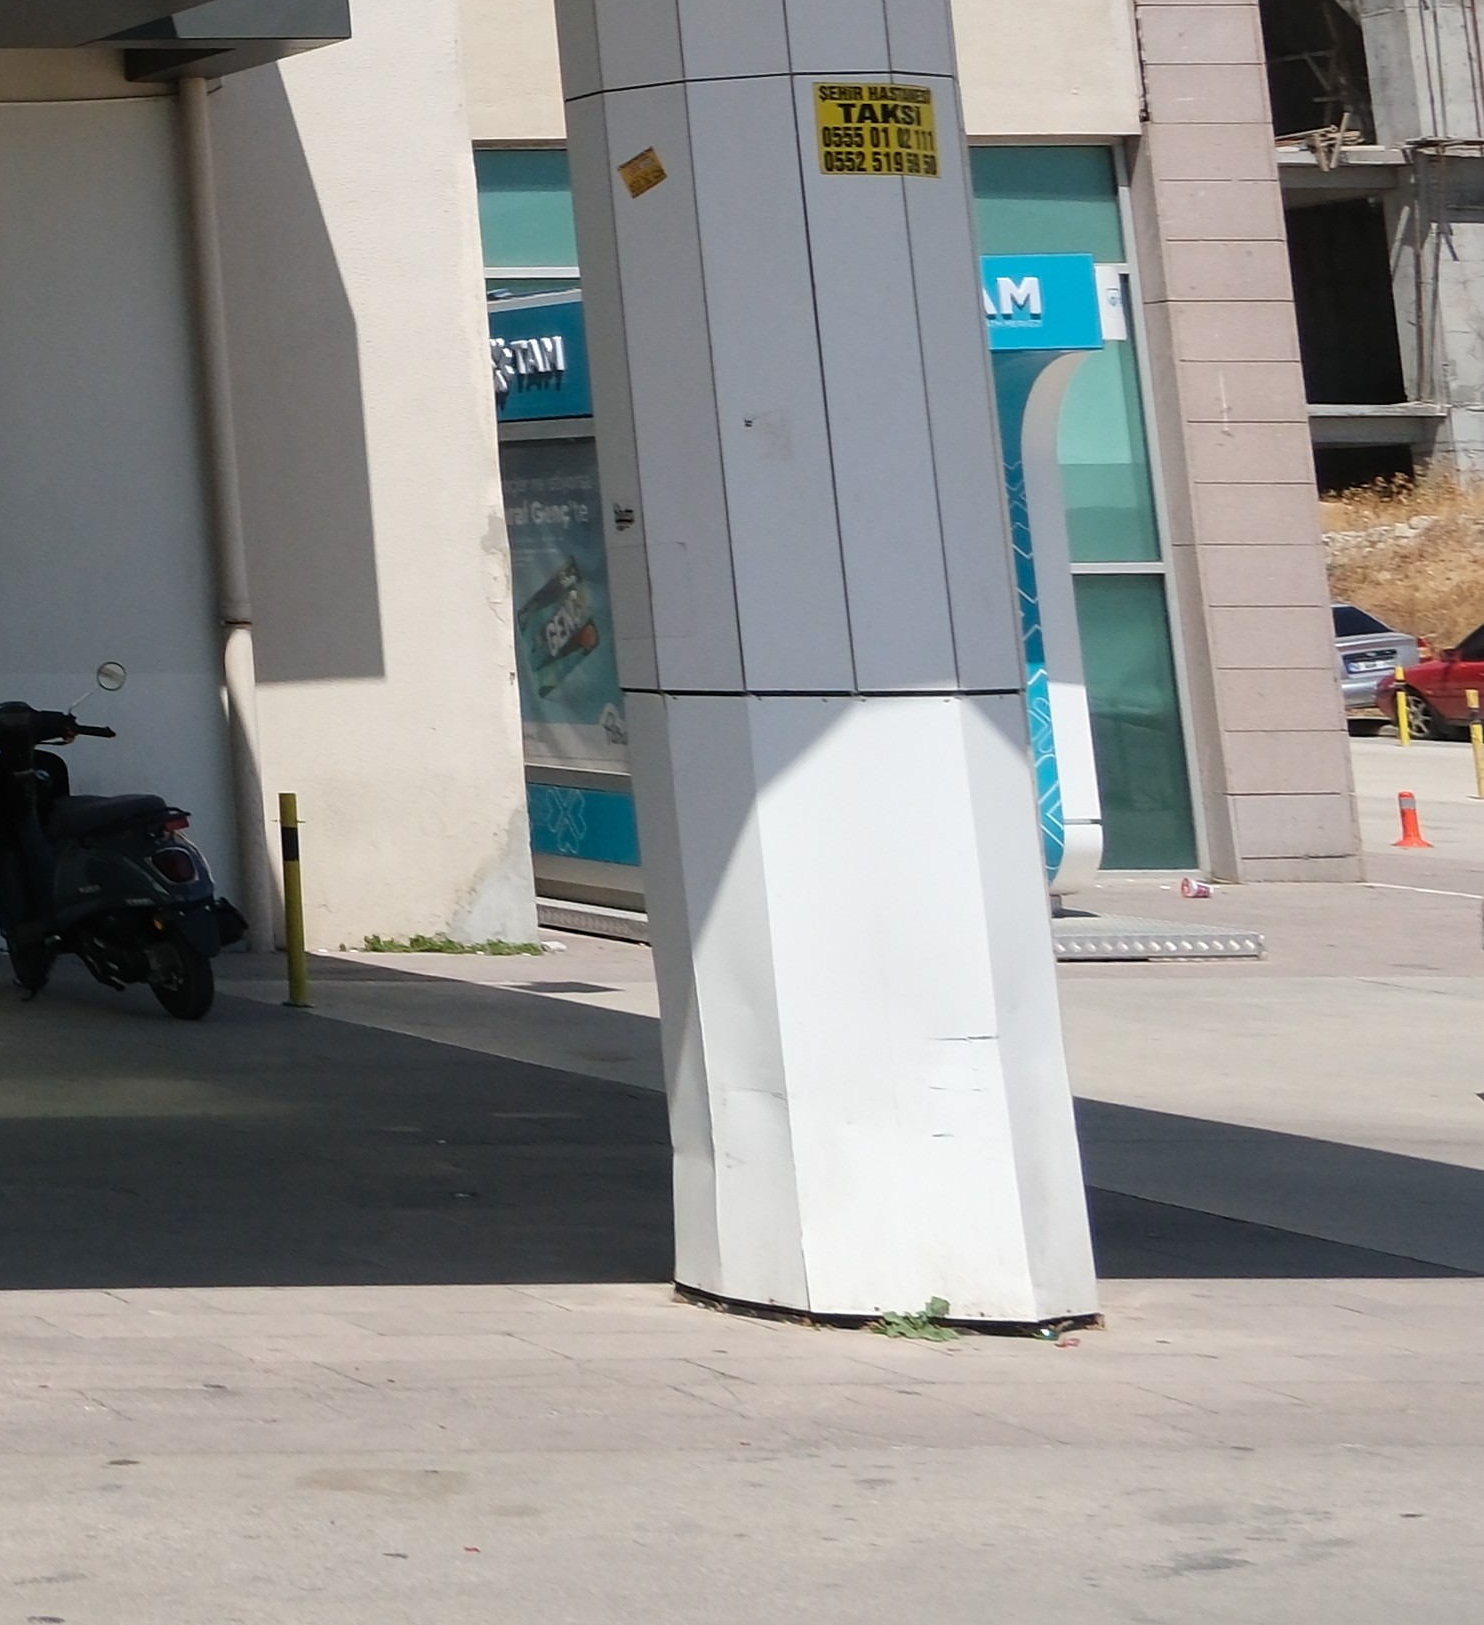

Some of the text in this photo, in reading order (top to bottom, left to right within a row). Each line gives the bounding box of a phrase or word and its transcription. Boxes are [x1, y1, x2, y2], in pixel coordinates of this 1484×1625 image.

[837, 103, 921, 126] TAKSİ
[822, 126, 864, 148] 0555
[869, 127, 891, 148] 01
[824, 151, 867, 172] 0552
[872, 151, 903, 172] 519
